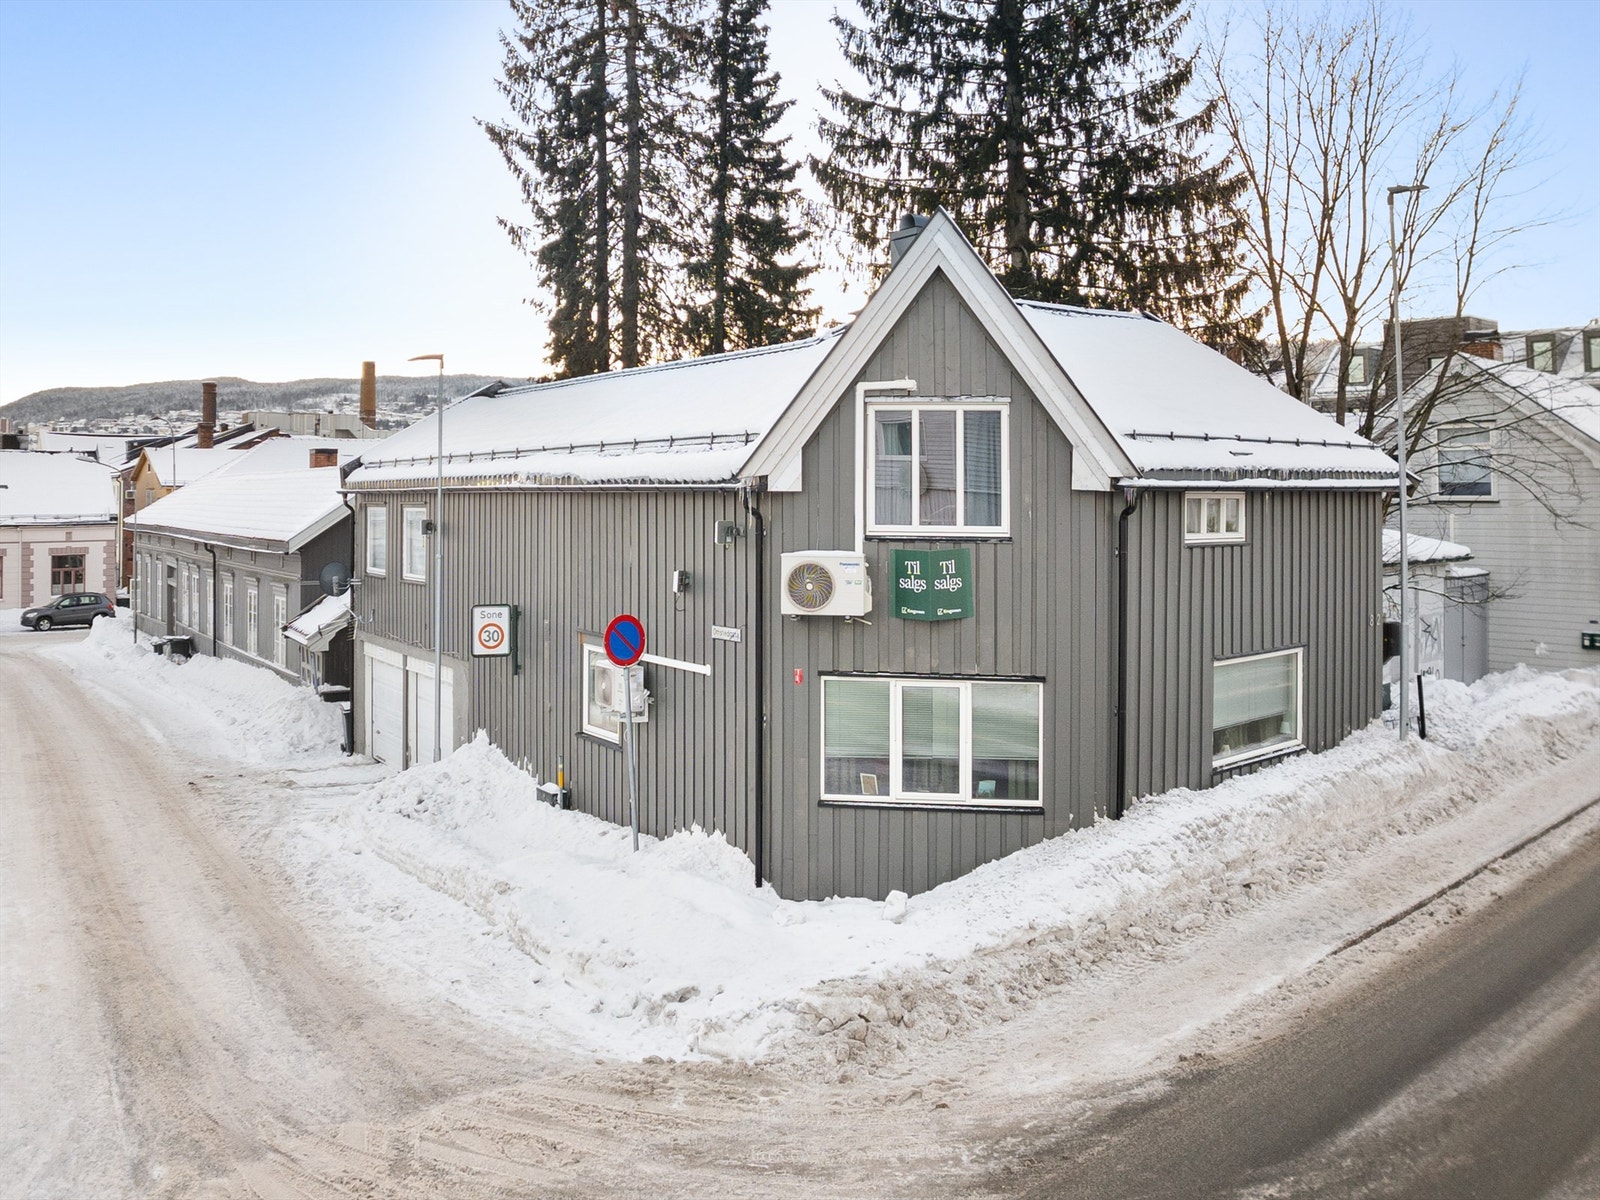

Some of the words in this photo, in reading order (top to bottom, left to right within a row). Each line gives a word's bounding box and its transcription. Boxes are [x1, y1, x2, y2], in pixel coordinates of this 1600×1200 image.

[904, 560, 920, 574] Til
[939, 559, 956, 574] Til
[899, 574, 927, 593] salgs
[934, 574, 962, 592] salgs
[480, 610, 502, 619] Sone
[1369, 613, 1381, 627] 82
[483, 629, 500, 642] 30
